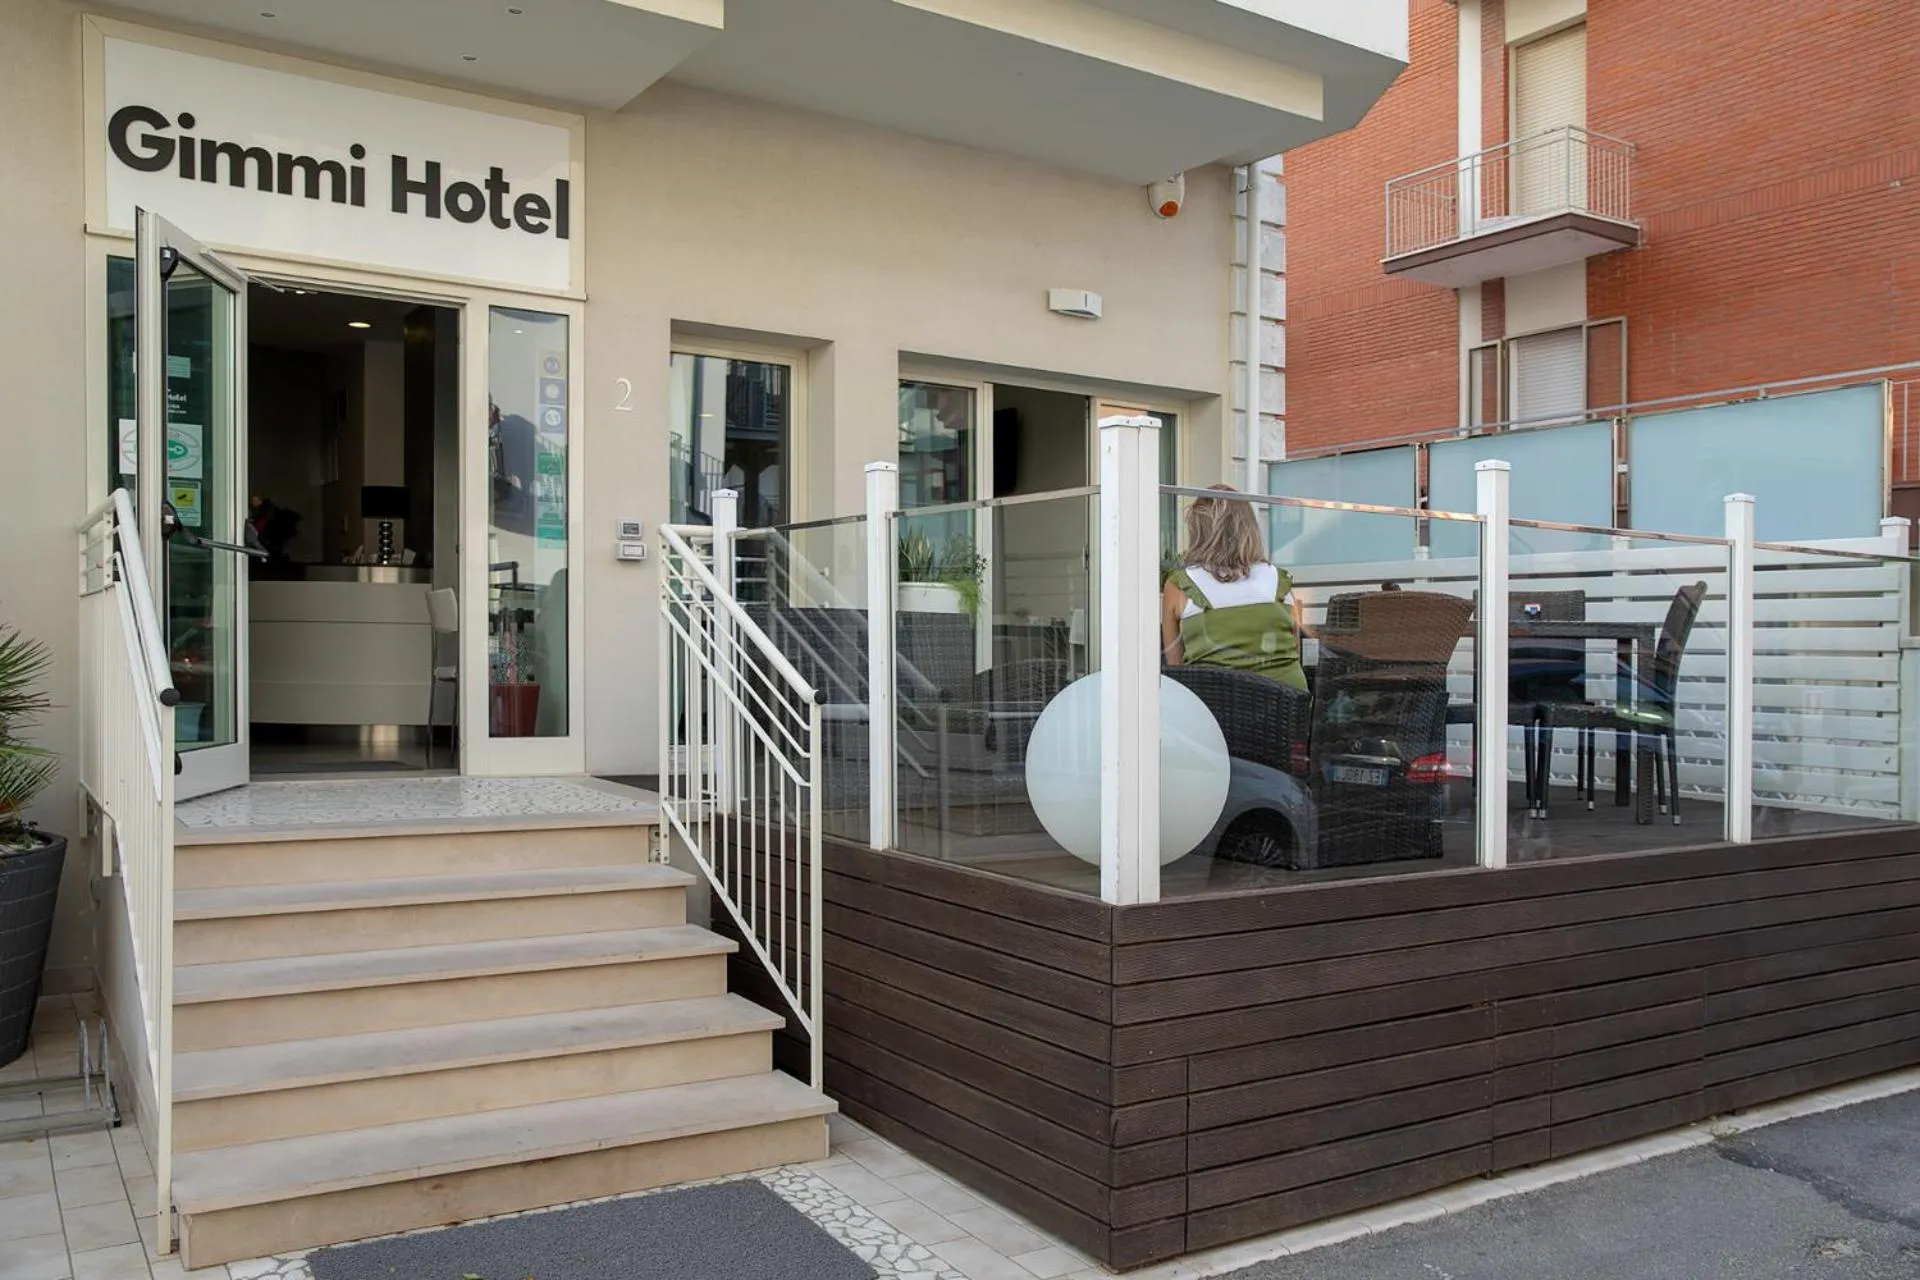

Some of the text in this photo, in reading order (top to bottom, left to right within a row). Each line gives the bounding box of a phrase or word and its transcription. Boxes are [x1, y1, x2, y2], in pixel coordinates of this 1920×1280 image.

[108, 105, 569, 239] Gimmi Hotel
[615, 377, 632, 411] 2
